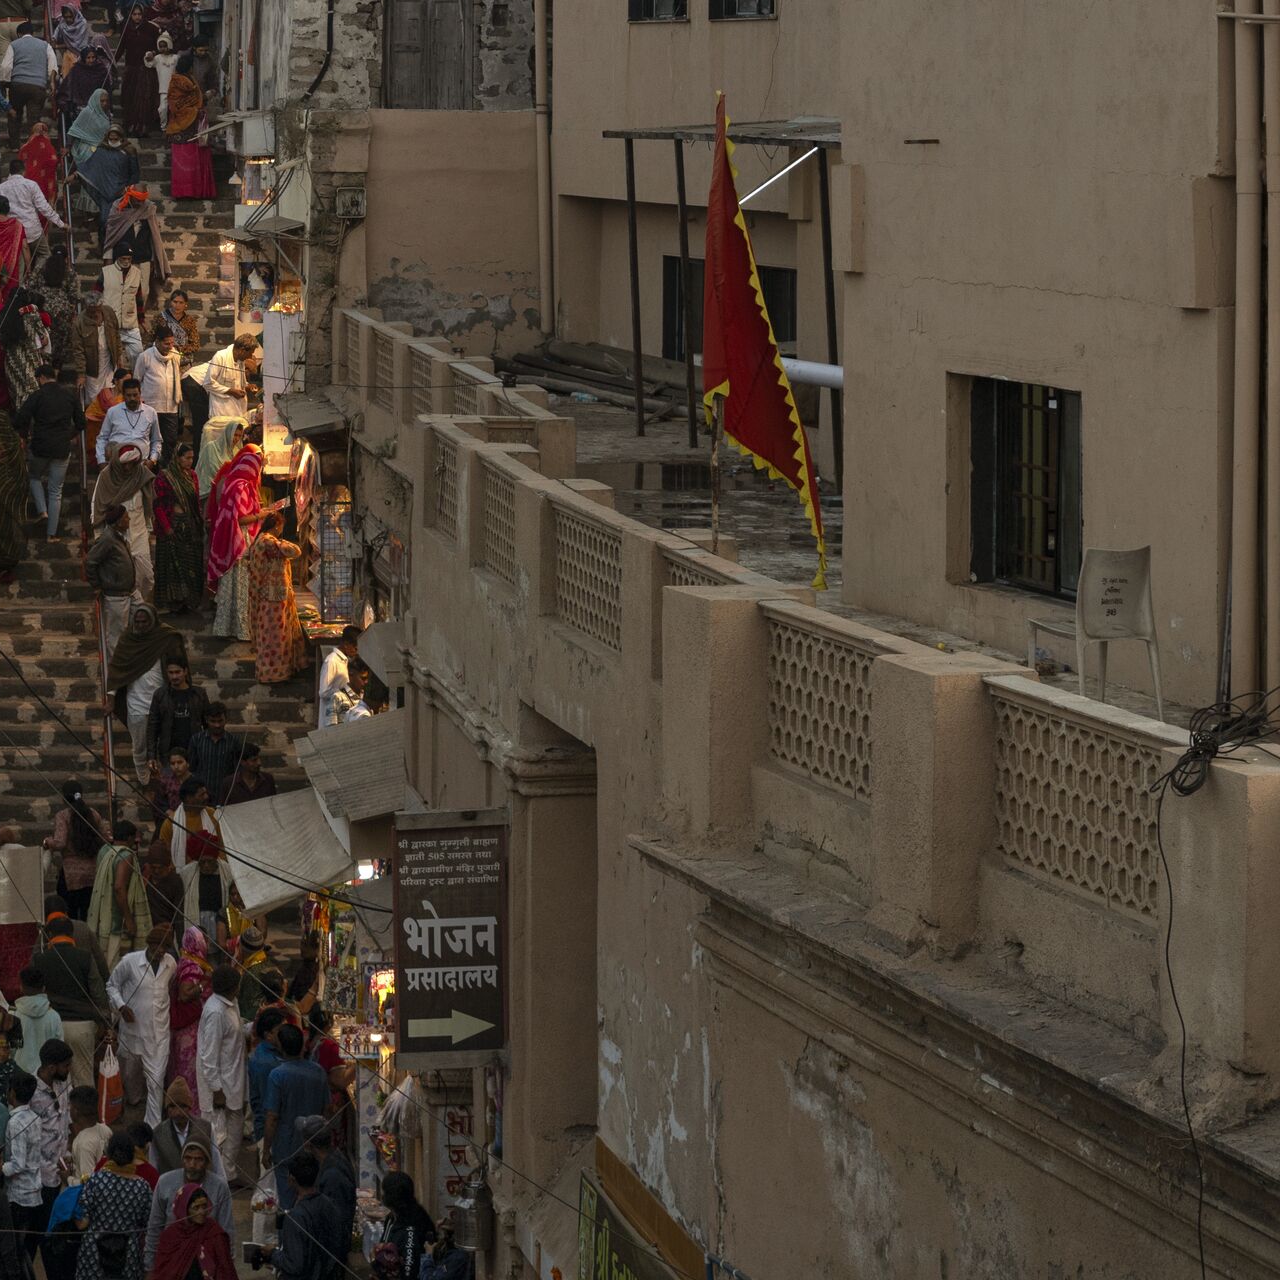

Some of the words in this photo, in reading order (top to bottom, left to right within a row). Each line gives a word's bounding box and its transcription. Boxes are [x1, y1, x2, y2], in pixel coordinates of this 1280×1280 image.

[398, 839, 408, 849] श्री
[411, 840, 436, 850] द्वारका
[428, 852, 445, 860] 505
[447, 852, 472, 860] समस्त
[475, 851, 492, 859] तथा
[399, 864, 408, 874] श्री
[411, 864, 453, 874] द्वारकाधीश
[456, 864, 474, 872] मंदिर
[477, 862, 500, 873] पुजारी
[400, 877, 426, 886] परिवार
[447, 877, 464, 885] द्वारा
[467, 874, 499, 883] संचालित
[403, 900, 498, 959] भोजन
[405, 965, 498, 991] प्रसादालय
